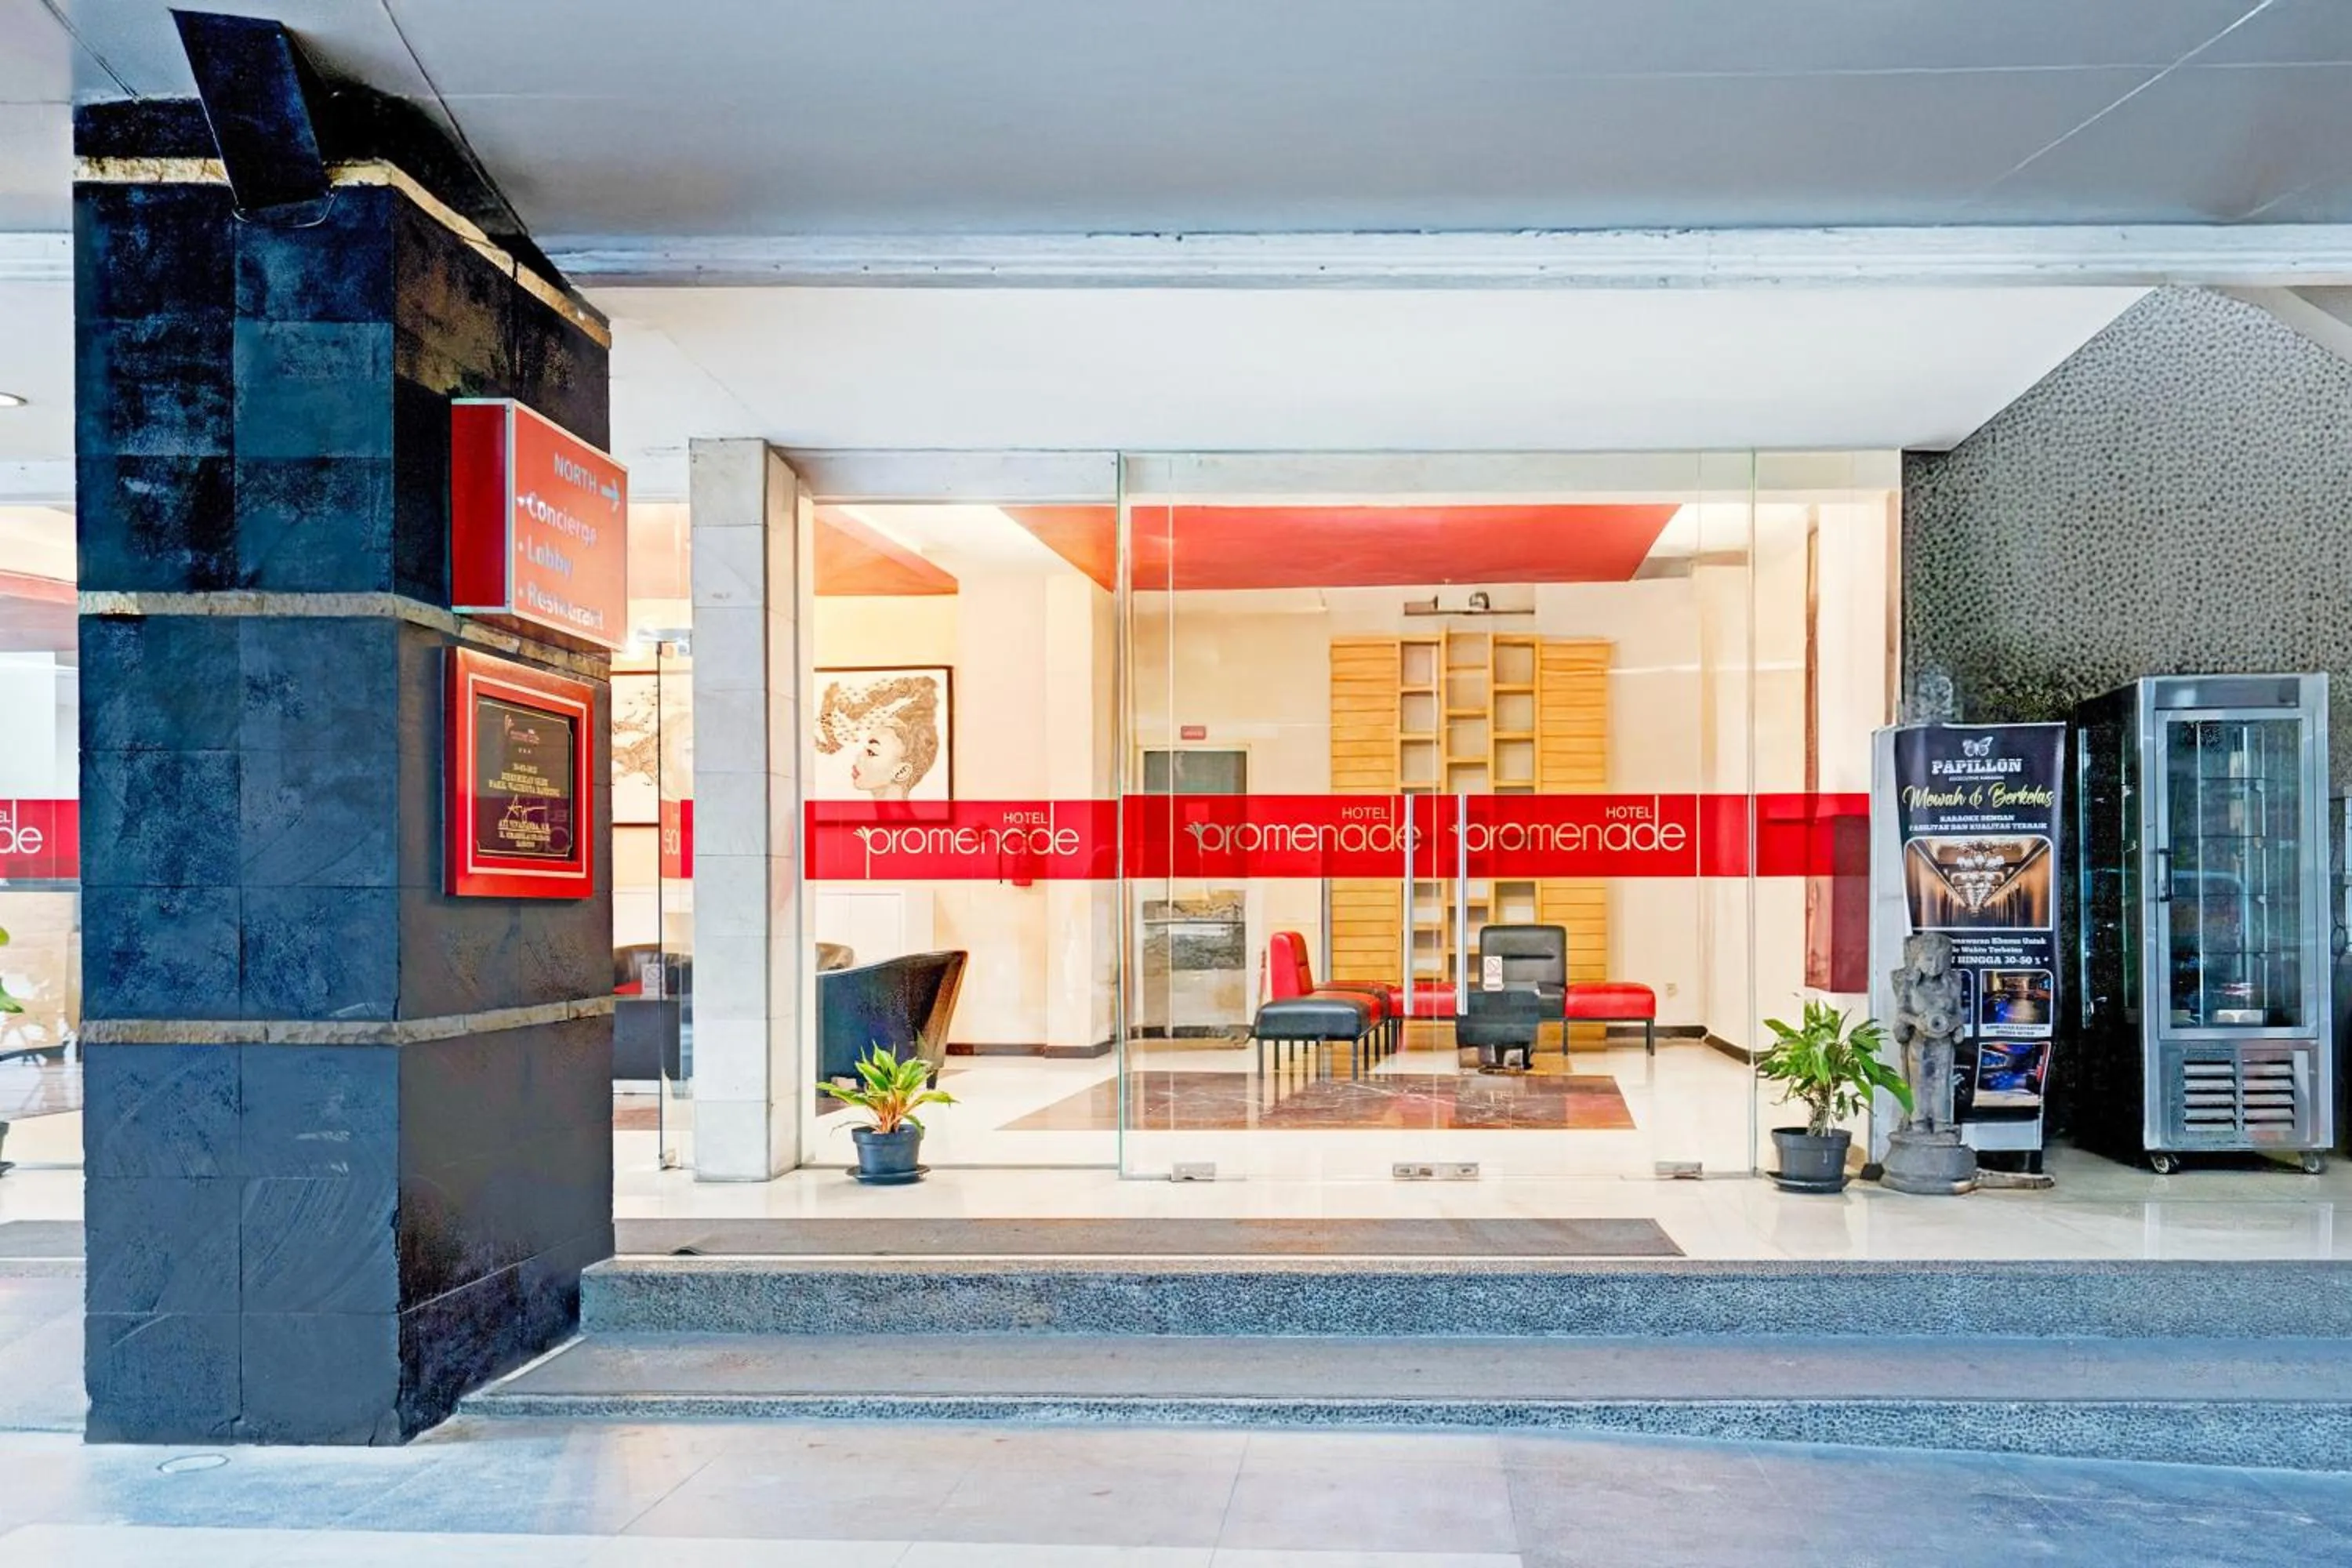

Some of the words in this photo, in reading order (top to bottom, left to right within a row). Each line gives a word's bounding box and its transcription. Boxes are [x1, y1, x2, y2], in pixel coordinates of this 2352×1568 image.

[554, 452, 597, 495] NORTH
[526, 490, 597, 548] Concierge
[527, 535, 573, 582] Lobby
[1931, 758, 2023, 775] PAPILLON
[1901, 785, 1967, 812] Mewah
[1987, 782, 2055, 808] Berkelas
[1003, 811, 1048, 824] HOTEL
[1198, 796, 1422, 859] promenade
[1341, 807, 1390, 820] HOTEL
[1465, 795, 1686, 852] promenade
[1605, 806, 1653, 819] HOTEL
[1957, 956, 2002, 965] HINGGA
